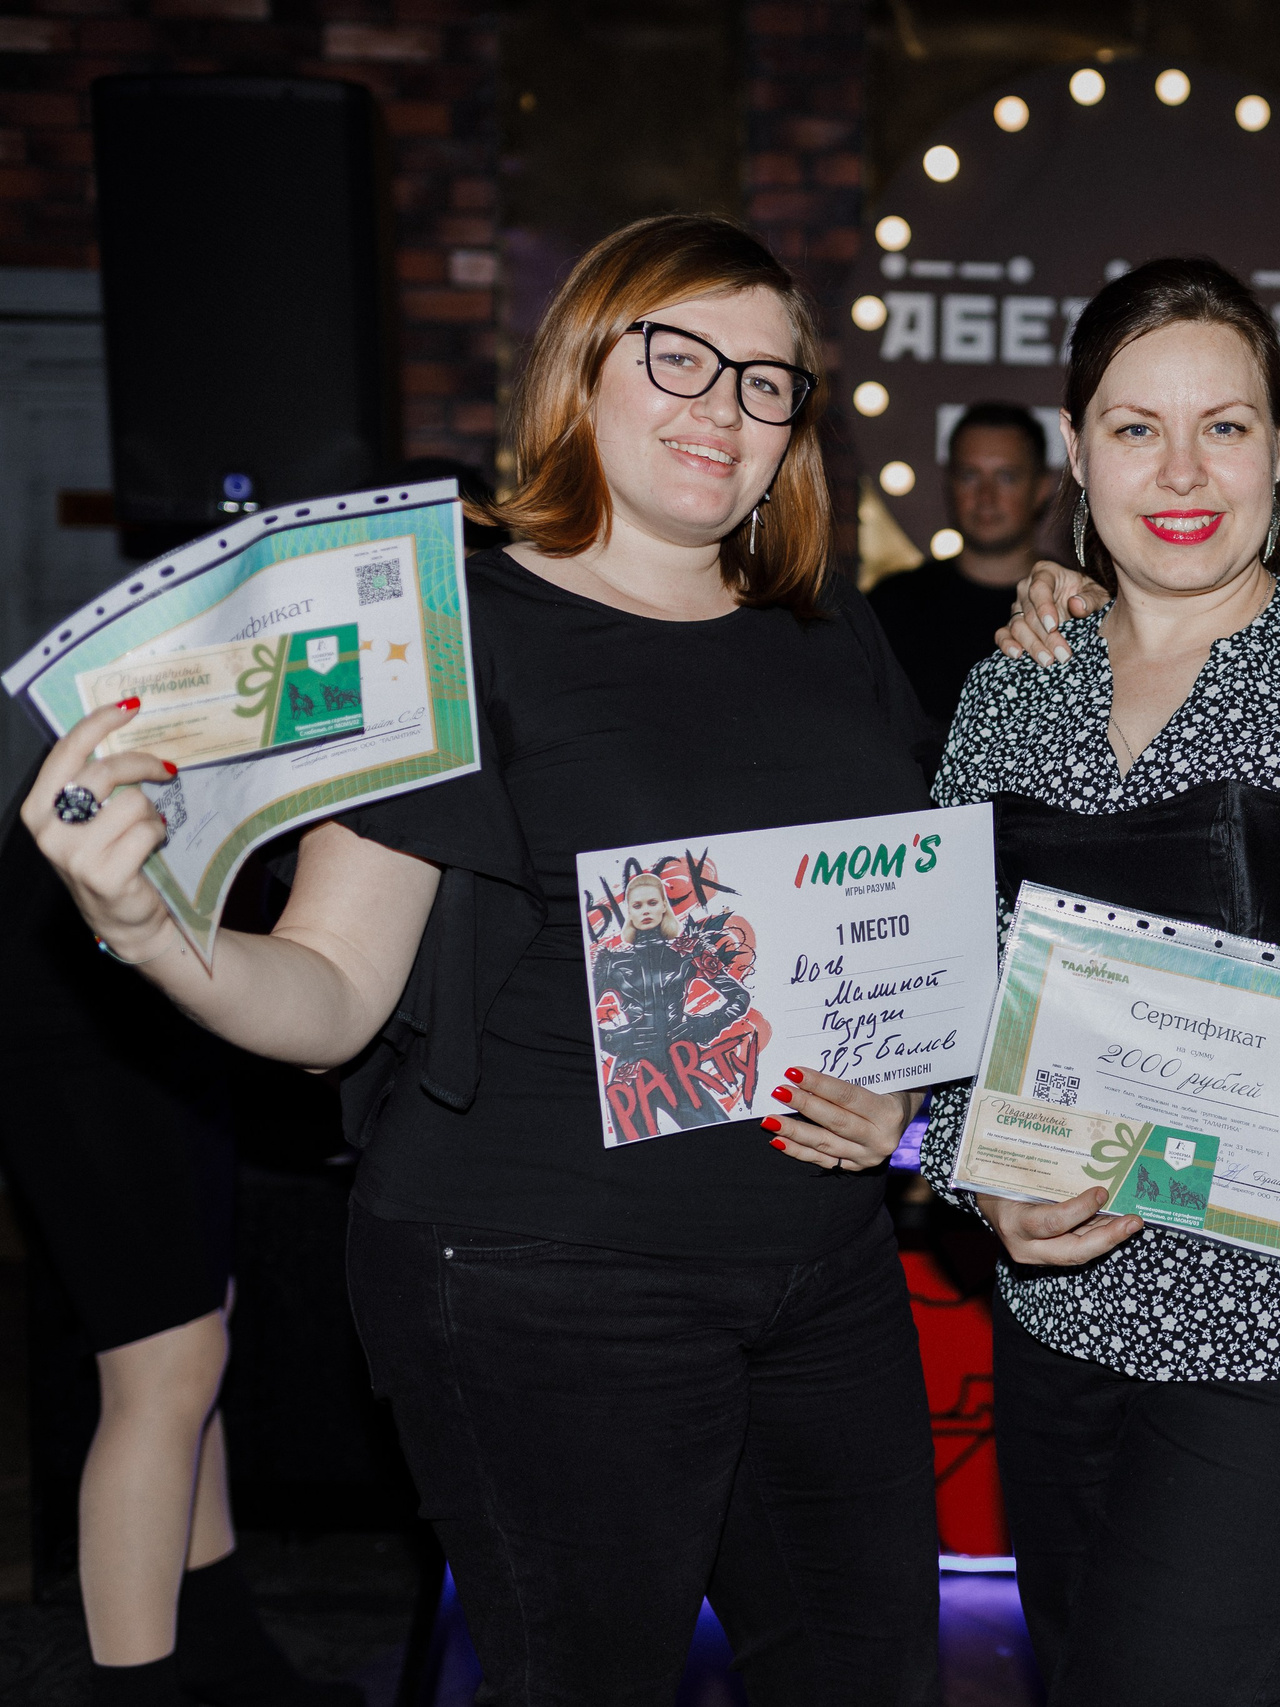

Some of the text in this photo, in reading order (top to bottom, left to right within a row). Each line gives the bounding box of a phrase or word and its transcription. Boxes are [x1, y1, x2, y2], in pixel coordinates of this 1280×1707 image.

[879, 292, 1083, 366] АБЕ
[845, 881, 896, 897] ИГРЫ РАЗУМА
[836, 914, 910, 946] 1 МЕСТО
[1130, 1000, 1267, 1049] Сертификат
[1176, 1045, 1215, 1061] на сумму
[606, 1030, 758, 1141] PARTY
[1097, 1044, 1264, 1100] 2000 рублей
[991, 1100, 1067, 1127] Подарочный
[996, 1114, 1073, 1138] СЕРТИФИКАТ
[1257, 1191, 1271, 1199] ООО
